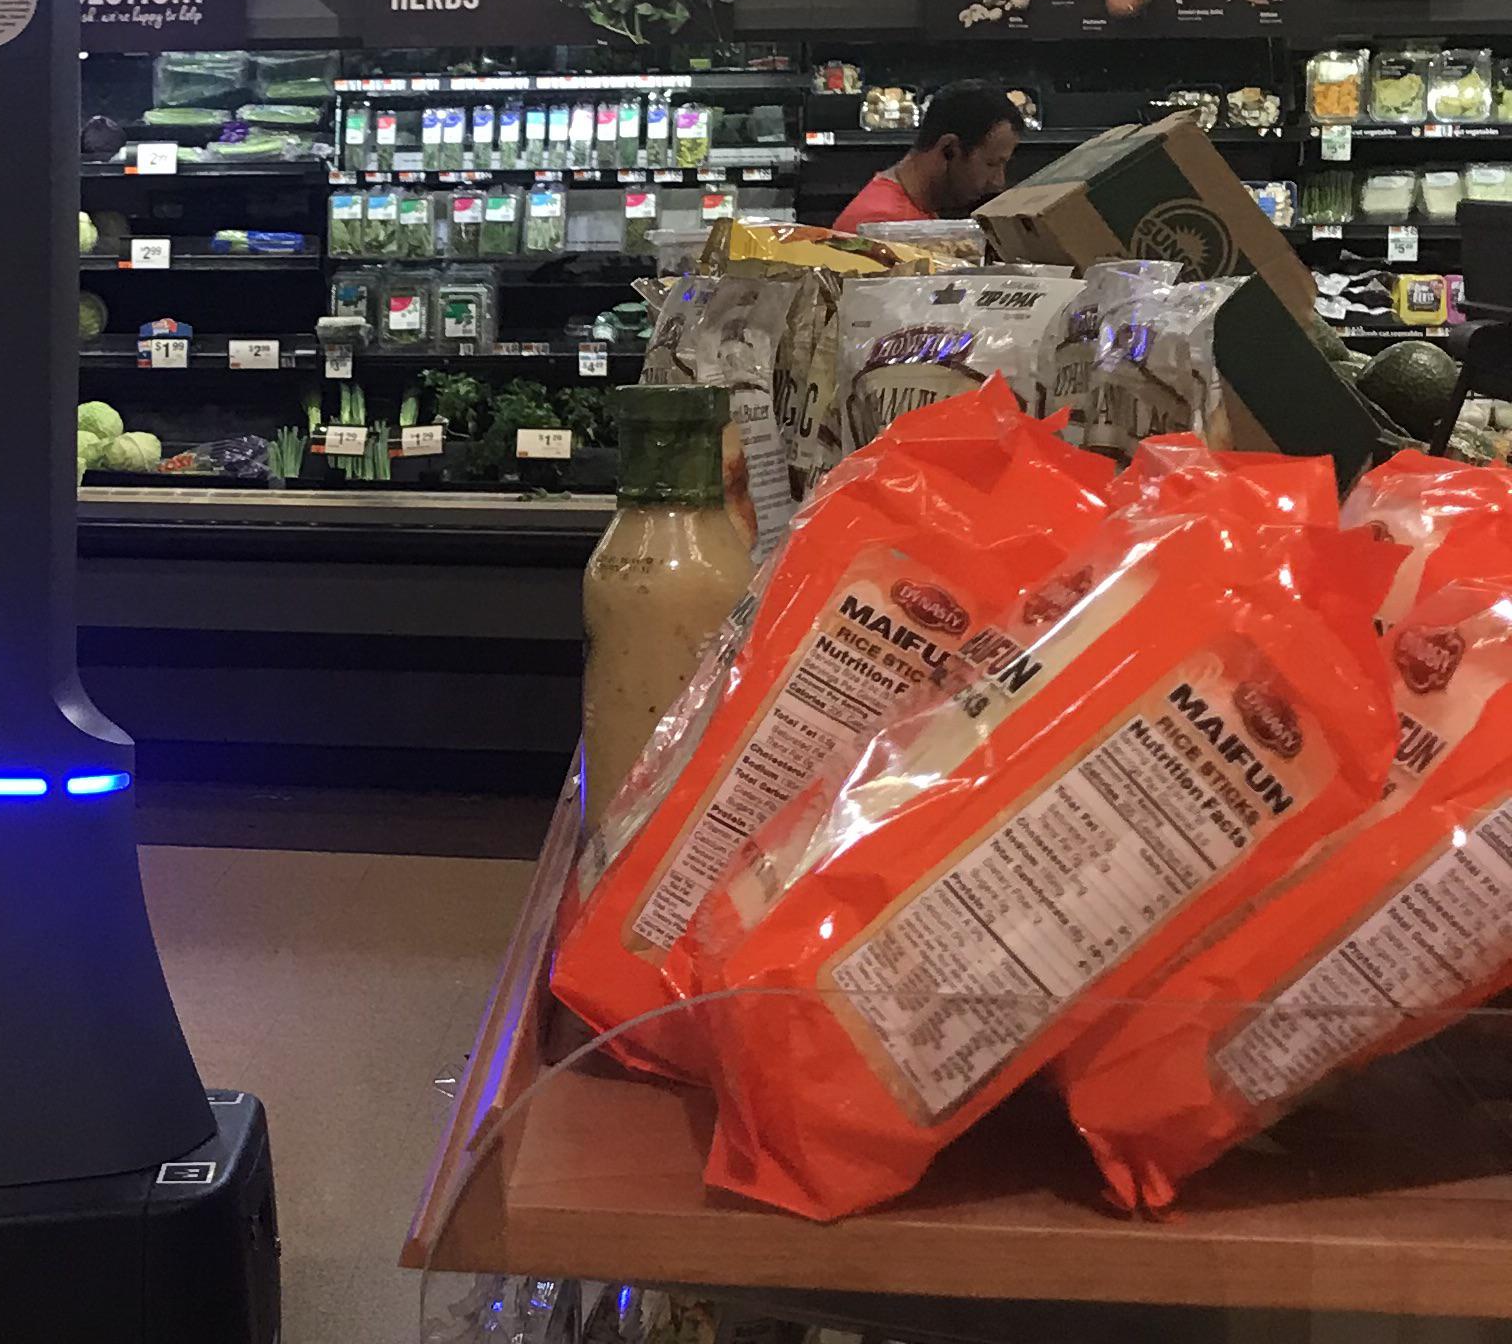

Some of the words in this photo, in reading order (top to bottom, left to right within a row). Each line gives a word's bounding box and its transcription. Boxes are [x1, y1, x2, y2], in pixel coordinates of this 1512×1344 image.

[835, 625, 882, 660] RICE
[838, 594, 951, 671] MAIFU
[815, 635, 896, 689] Nutrition
[772, 707, 799, 728] Total
[748, 742, 806, 780] Cholesterol
[1168, 683, 1294, 816] MAIFUN
[1128, 716, 1208, 805] Nutrition
[1199, 795, 1250, 850] Facts
